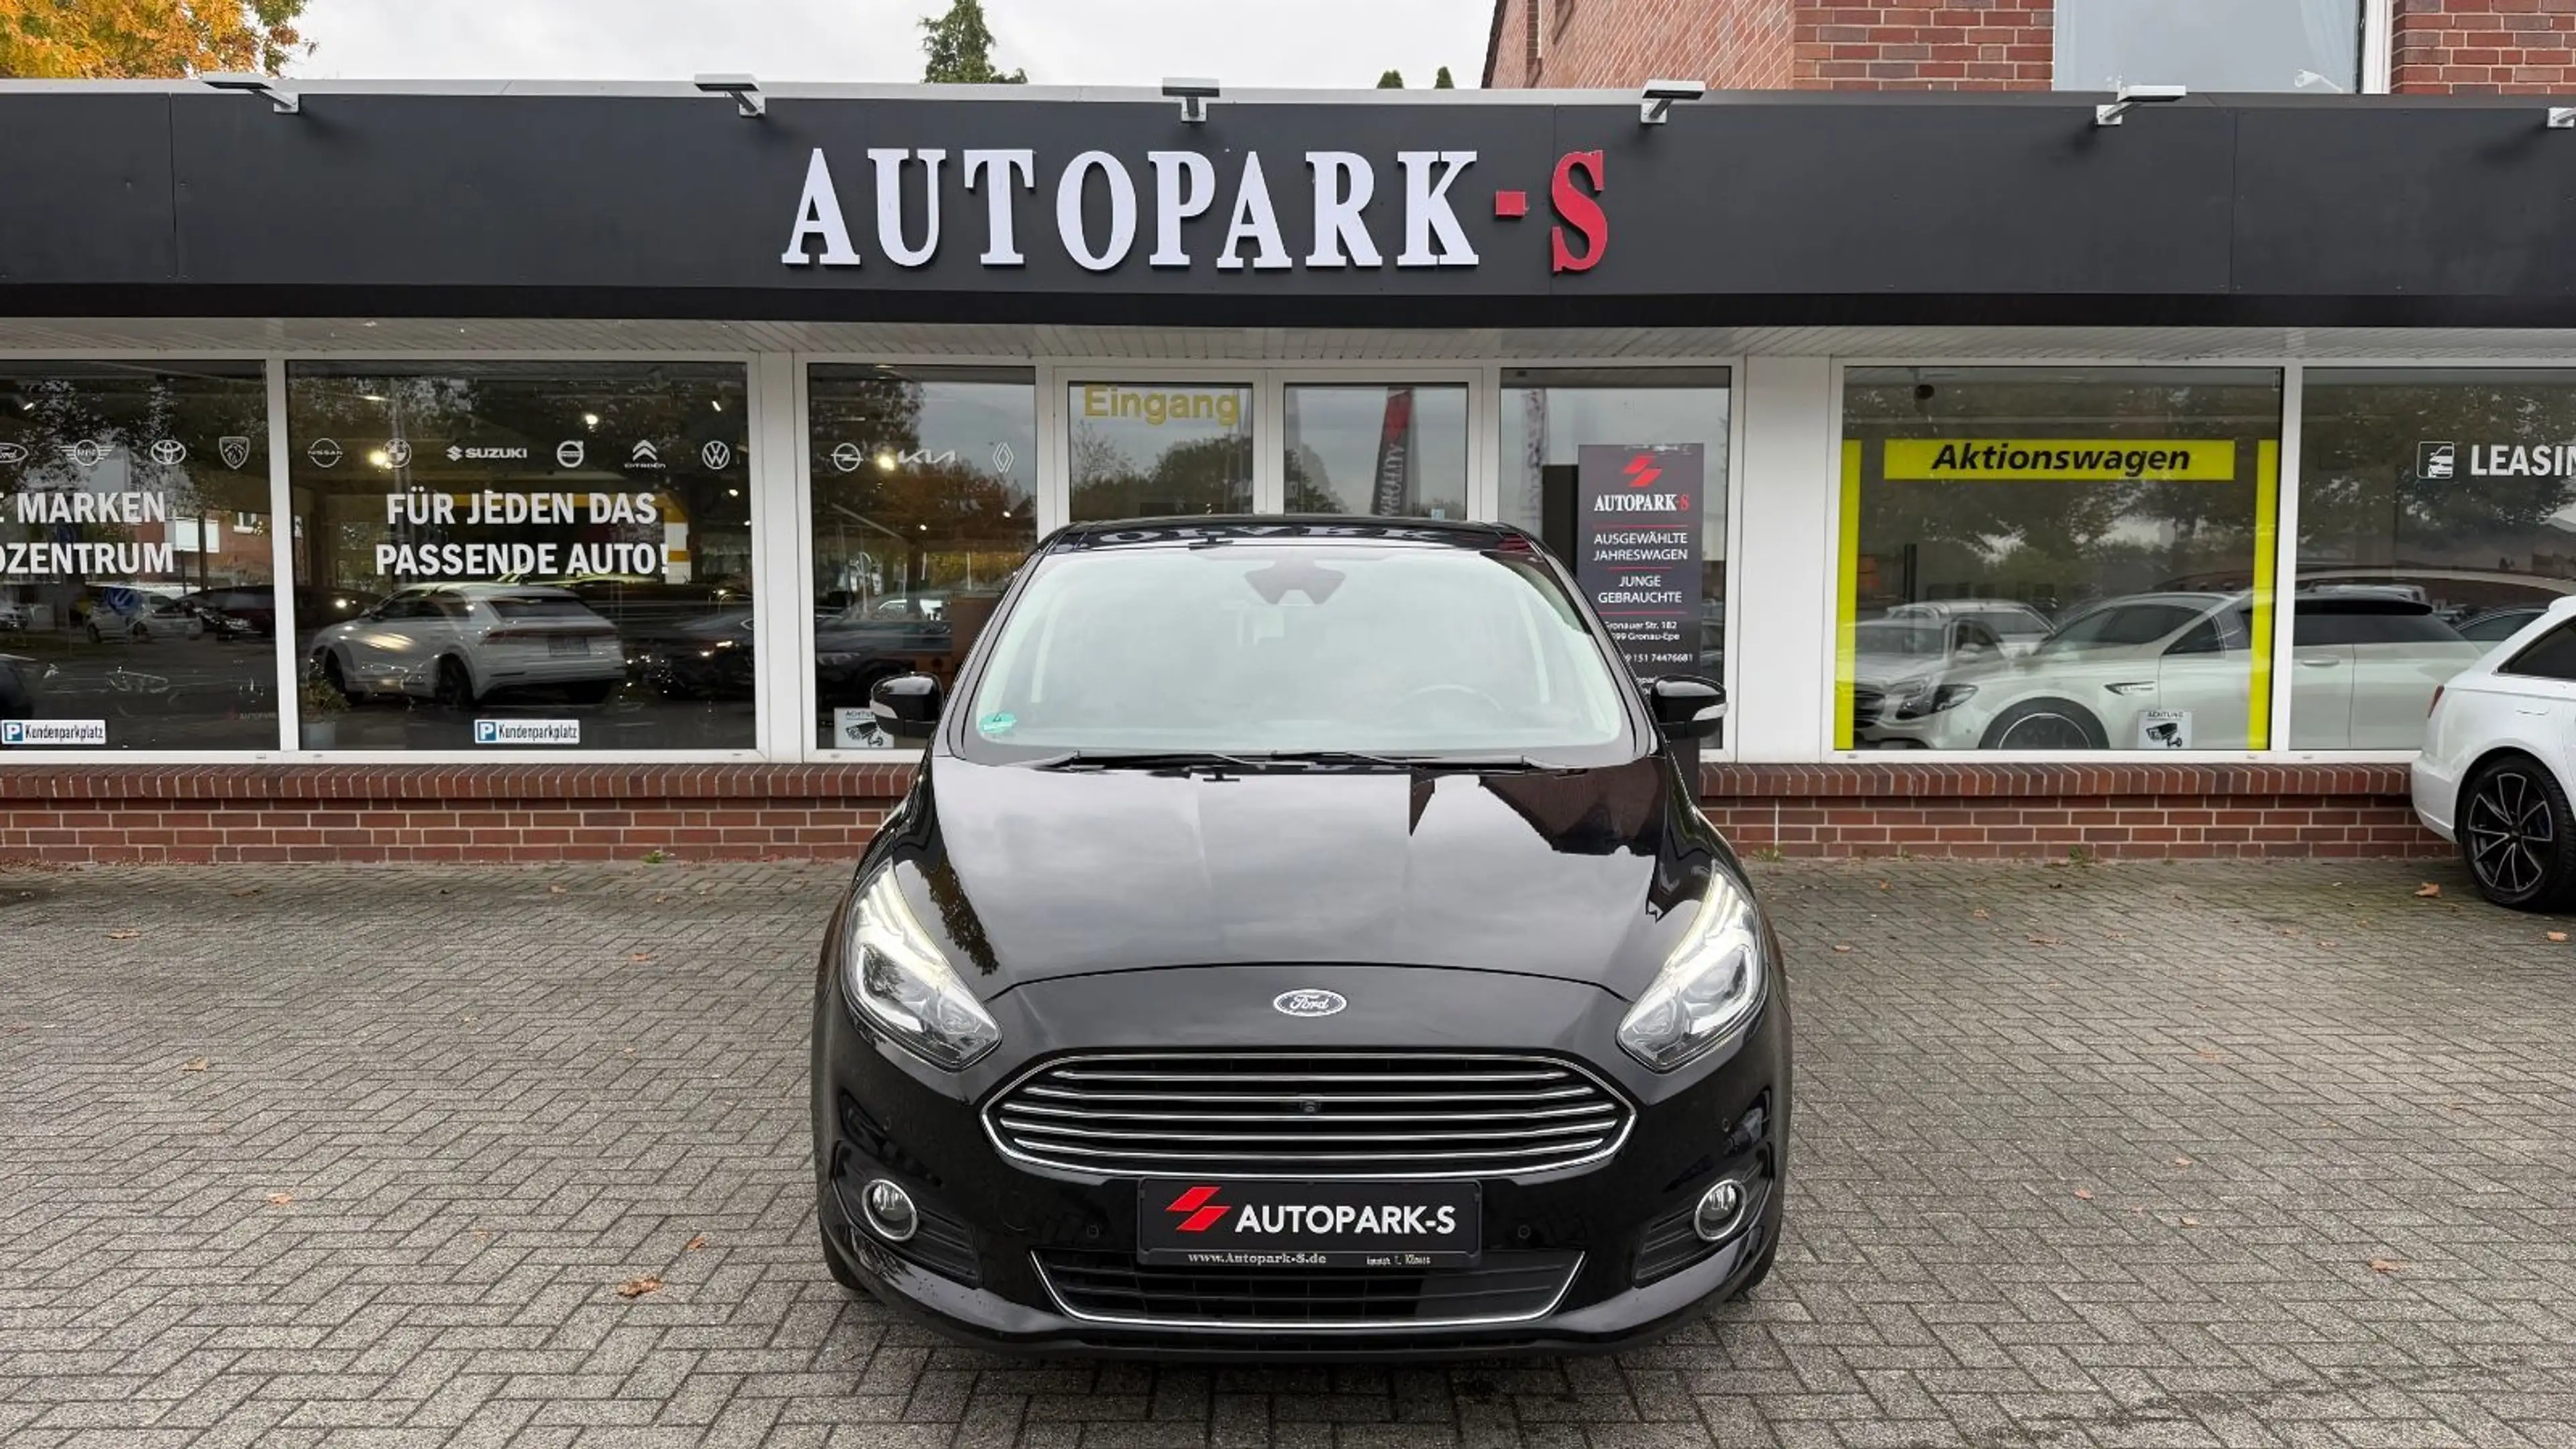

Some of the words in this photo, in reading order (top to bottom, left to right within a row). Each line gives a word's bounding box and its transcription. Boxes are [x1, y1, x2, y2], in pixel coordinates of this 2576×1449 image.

[782, 148, 1608, 274] AUTOPARK-S
[1084, 384, 1238, 426] Eingang
[466, 447, 527, 458] SUZUKI
[1931, 443, 2191, 477] Aktionswagen
[17, 492, 165, 523] MARKEN
[386, 486, 456, 525] FÜR
[466, 492, 574, 525] JEDEN
[589, 492, 657, 524] DAS
[1593, 531, 1688, 545] AUSGEWÄHLTE
[0, 542, 174, 574] ZENTRUM
[376, 543, 558, 576] PASSENDE
[565, 543, 669, 575] AUTO!
[1593, 549, 1688, 561] JAHRESWAGEN
[1619, 576, 1662, 587] JUNGE
[1598, 592, 1682, 603] GEBRAUCHTE
[1645, 621, 1660, 629] Str.
[1627, 632, 1680, 641] Gronau-Epe
[25, 724, 103, 741] Kundenparkplatz
[498, 724, 578, 741] Kundenparkplatz
[1289, 994, 1329, 1009] Ford
[1234, 1204, 1456, 1234] AUTOPARK-S
